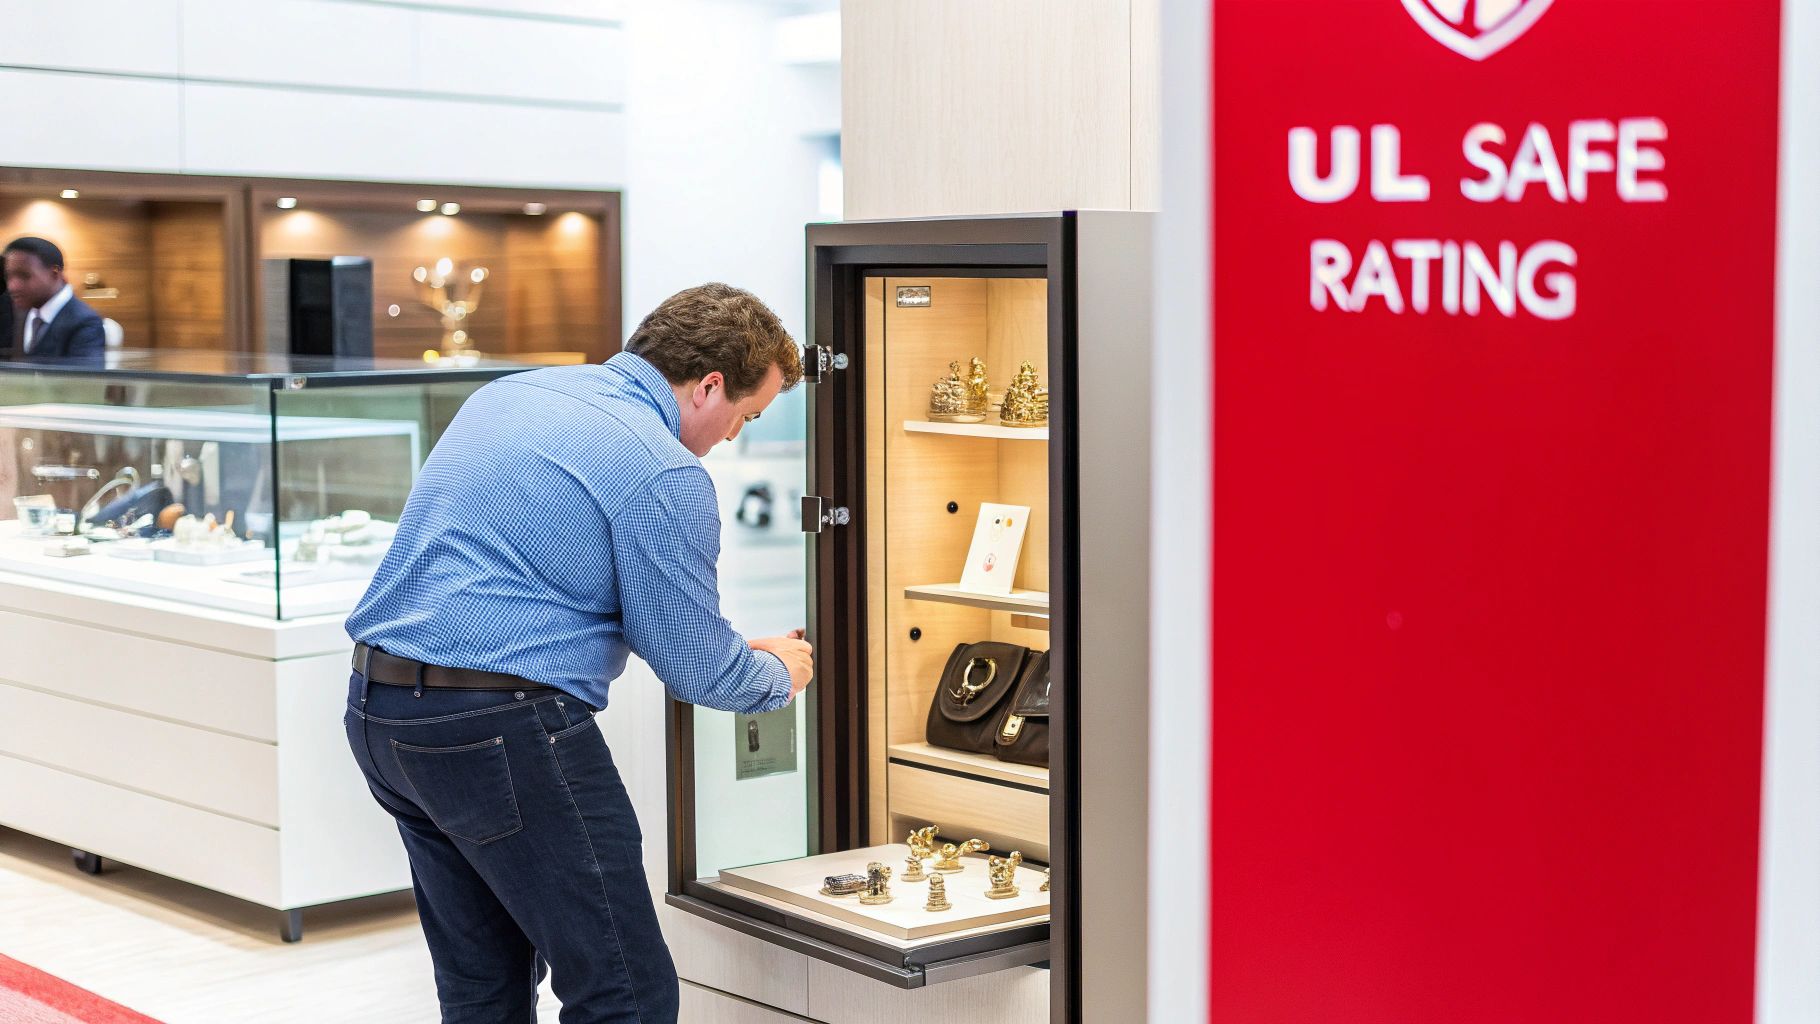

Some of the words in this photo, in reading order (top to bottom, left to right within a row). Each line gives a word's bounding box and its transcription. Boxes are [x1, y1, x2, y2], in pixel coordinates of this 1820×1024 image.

[1288, 124, 1431, 203] UL
[1460, 117, 1668, 202] SAFE
[1310, 239, 1577, 320] RATING
